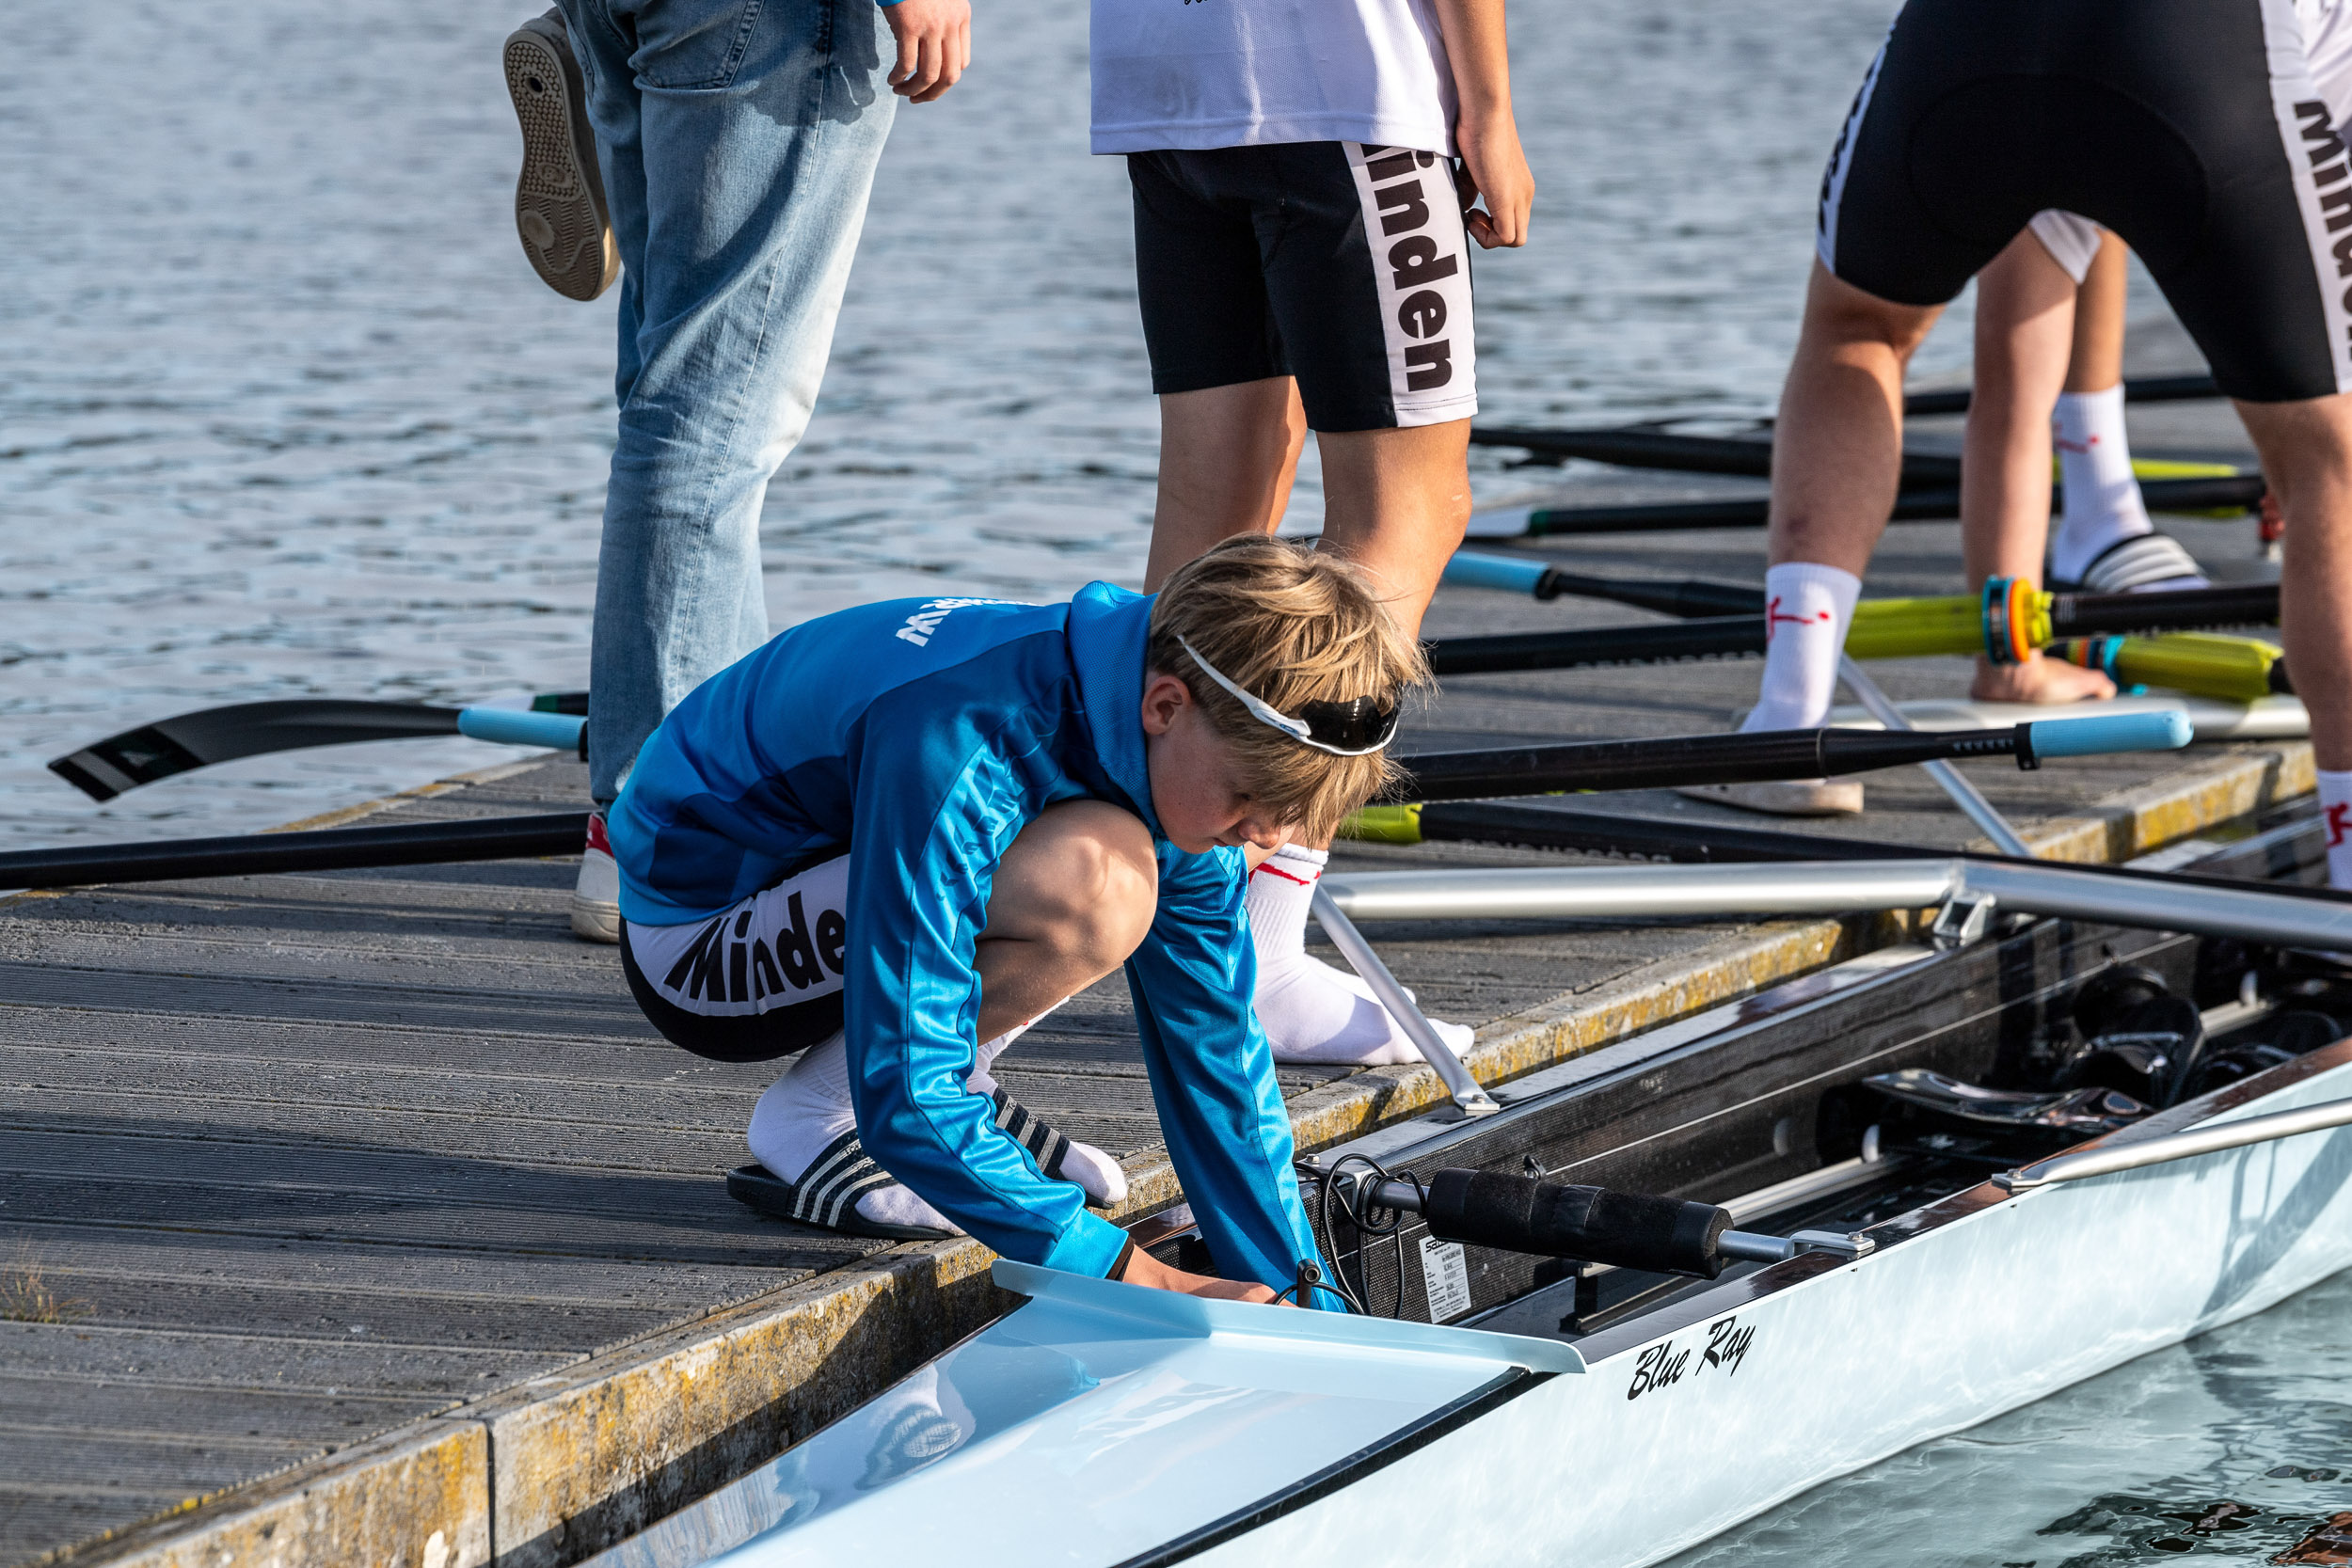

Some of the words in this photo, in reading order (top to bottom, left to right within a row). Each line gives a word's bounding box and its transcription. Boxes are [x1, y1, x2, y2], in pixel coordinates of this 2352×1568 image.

[1360, 144, 1459, 392] inden
[1627, 1339, 1691, 1401] Blue
[1694, 1315, 1756, 1377] Ray
